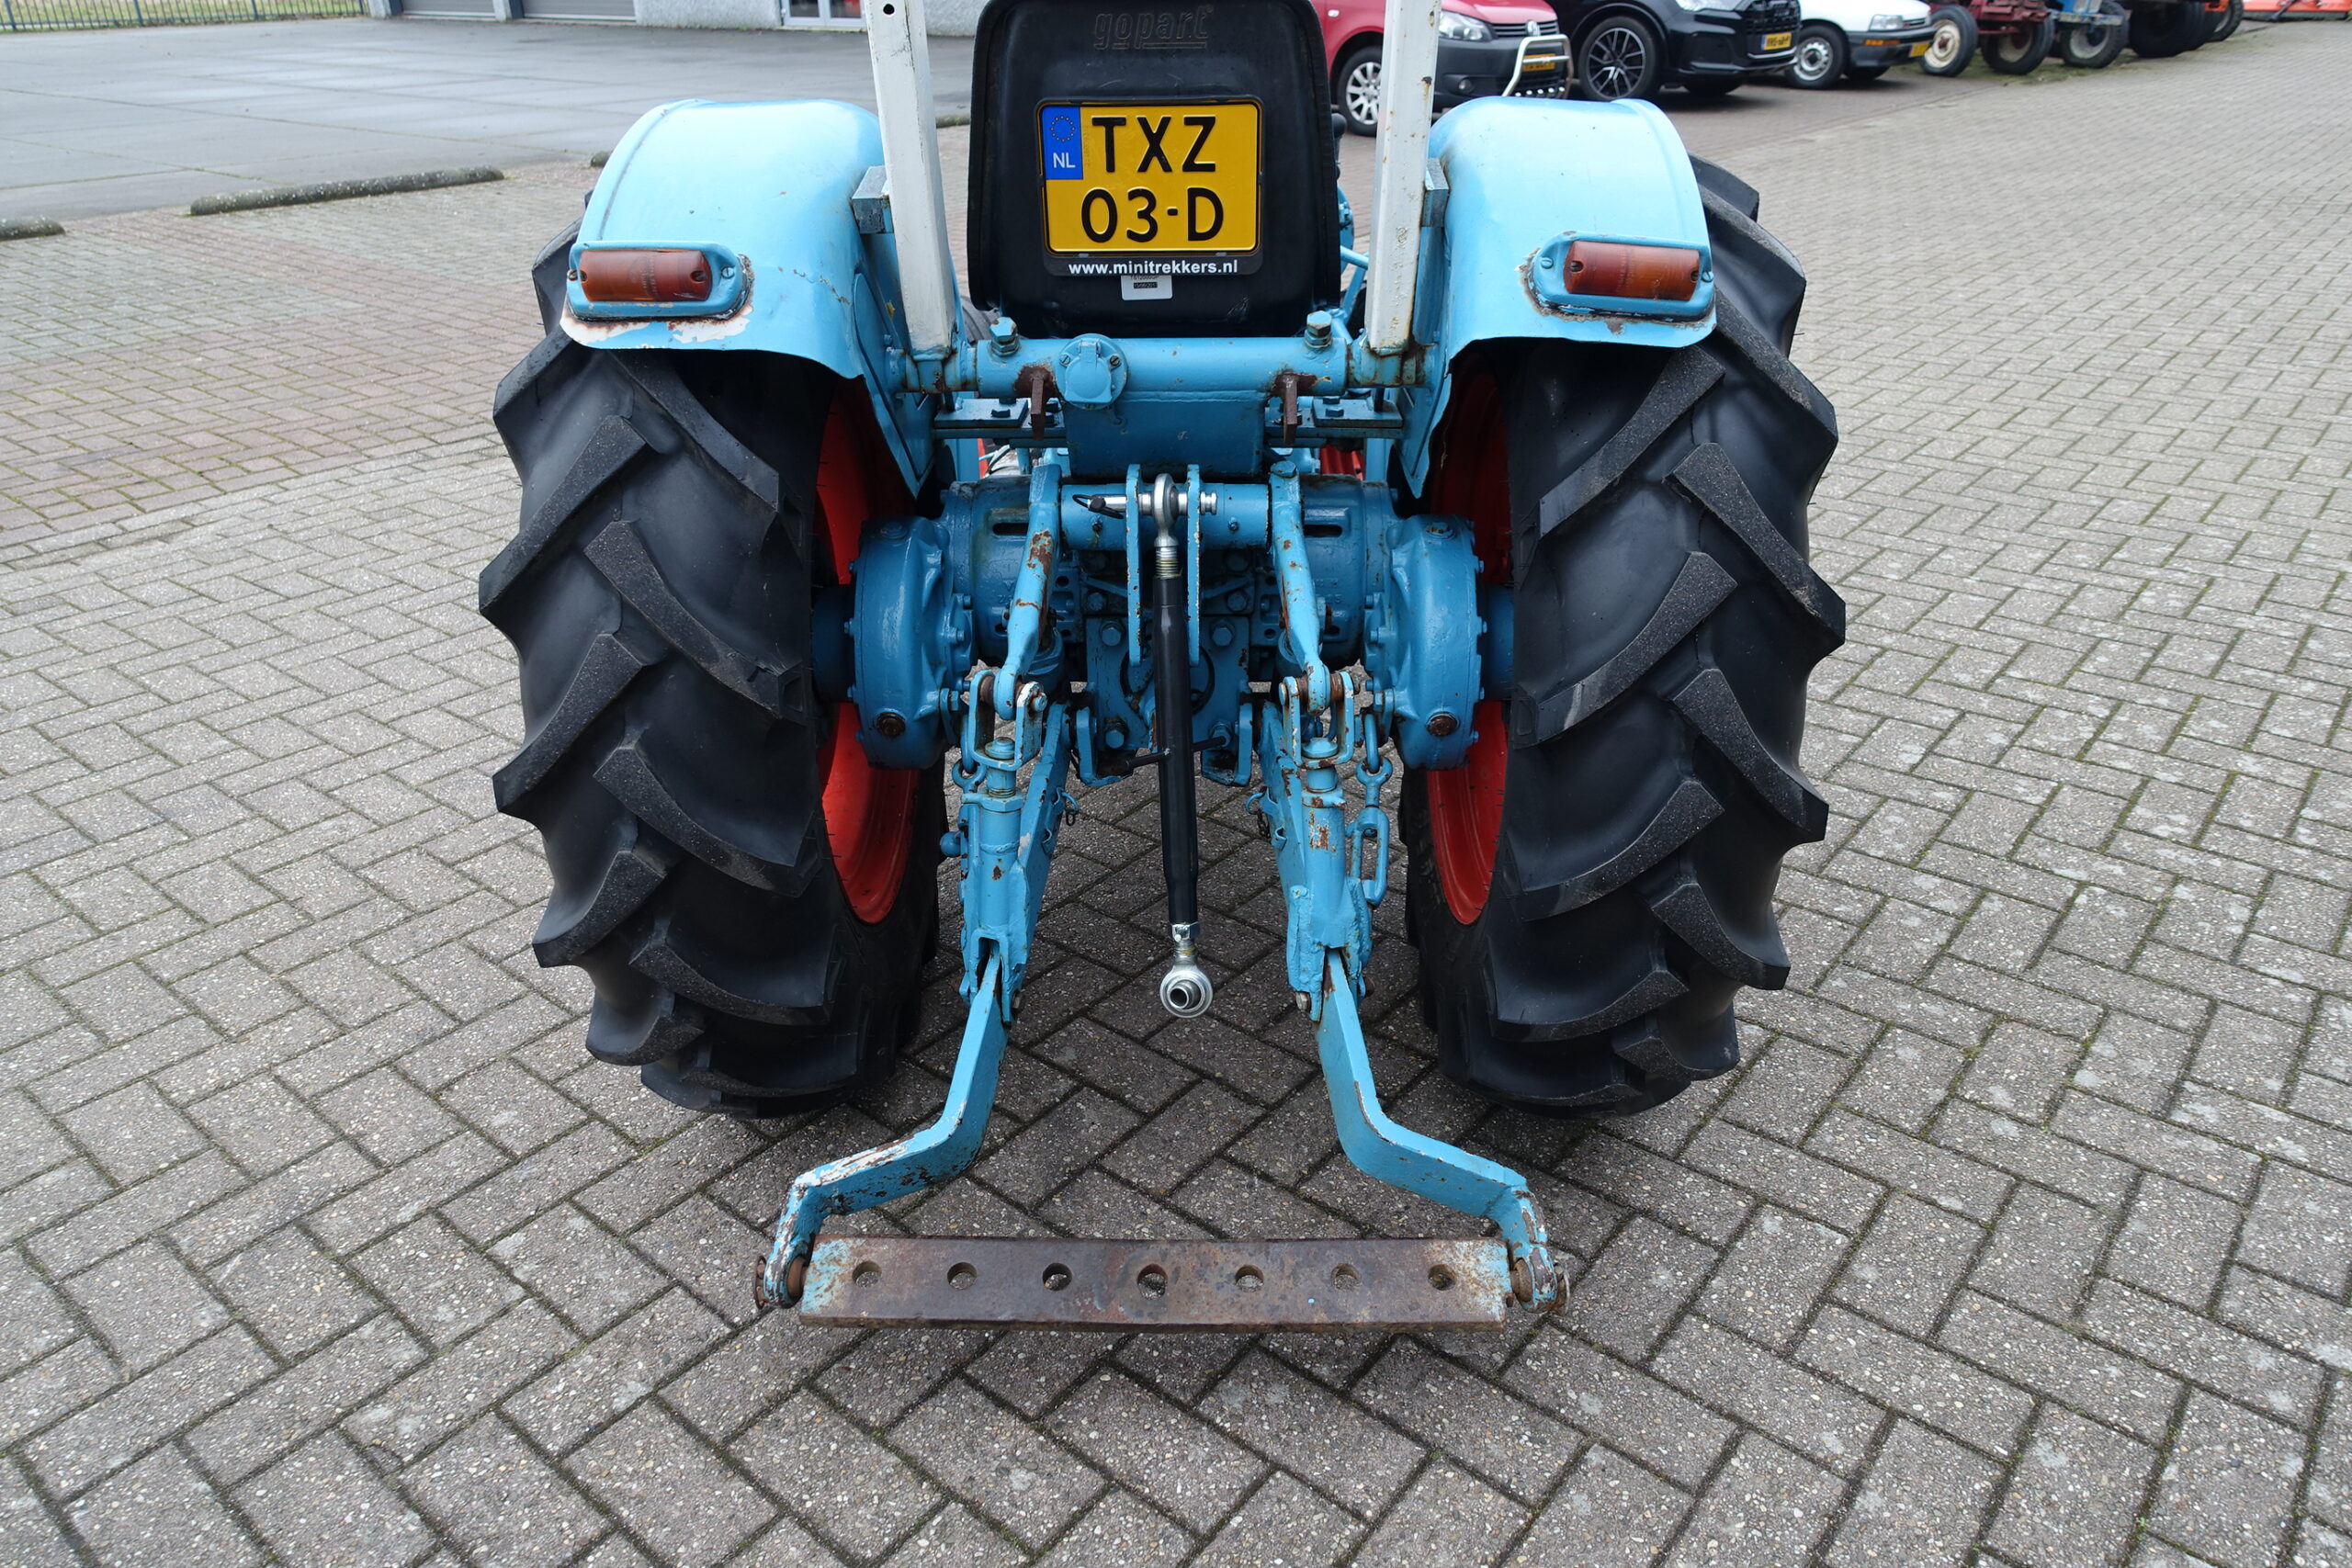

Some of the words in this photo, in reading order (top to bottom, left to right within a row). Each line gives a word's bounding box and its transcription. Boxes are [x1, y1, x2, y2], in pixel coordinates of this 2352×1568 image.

[1093, 5, 1209, 50] gopart
[1053, 152, 1076, 168] NL
[1091, 116, 1216, 173] TXZ
[1080, 186, 1225, 243] 03-D
[1068, 259, 1238, 275] www.minitrekkers.nl
